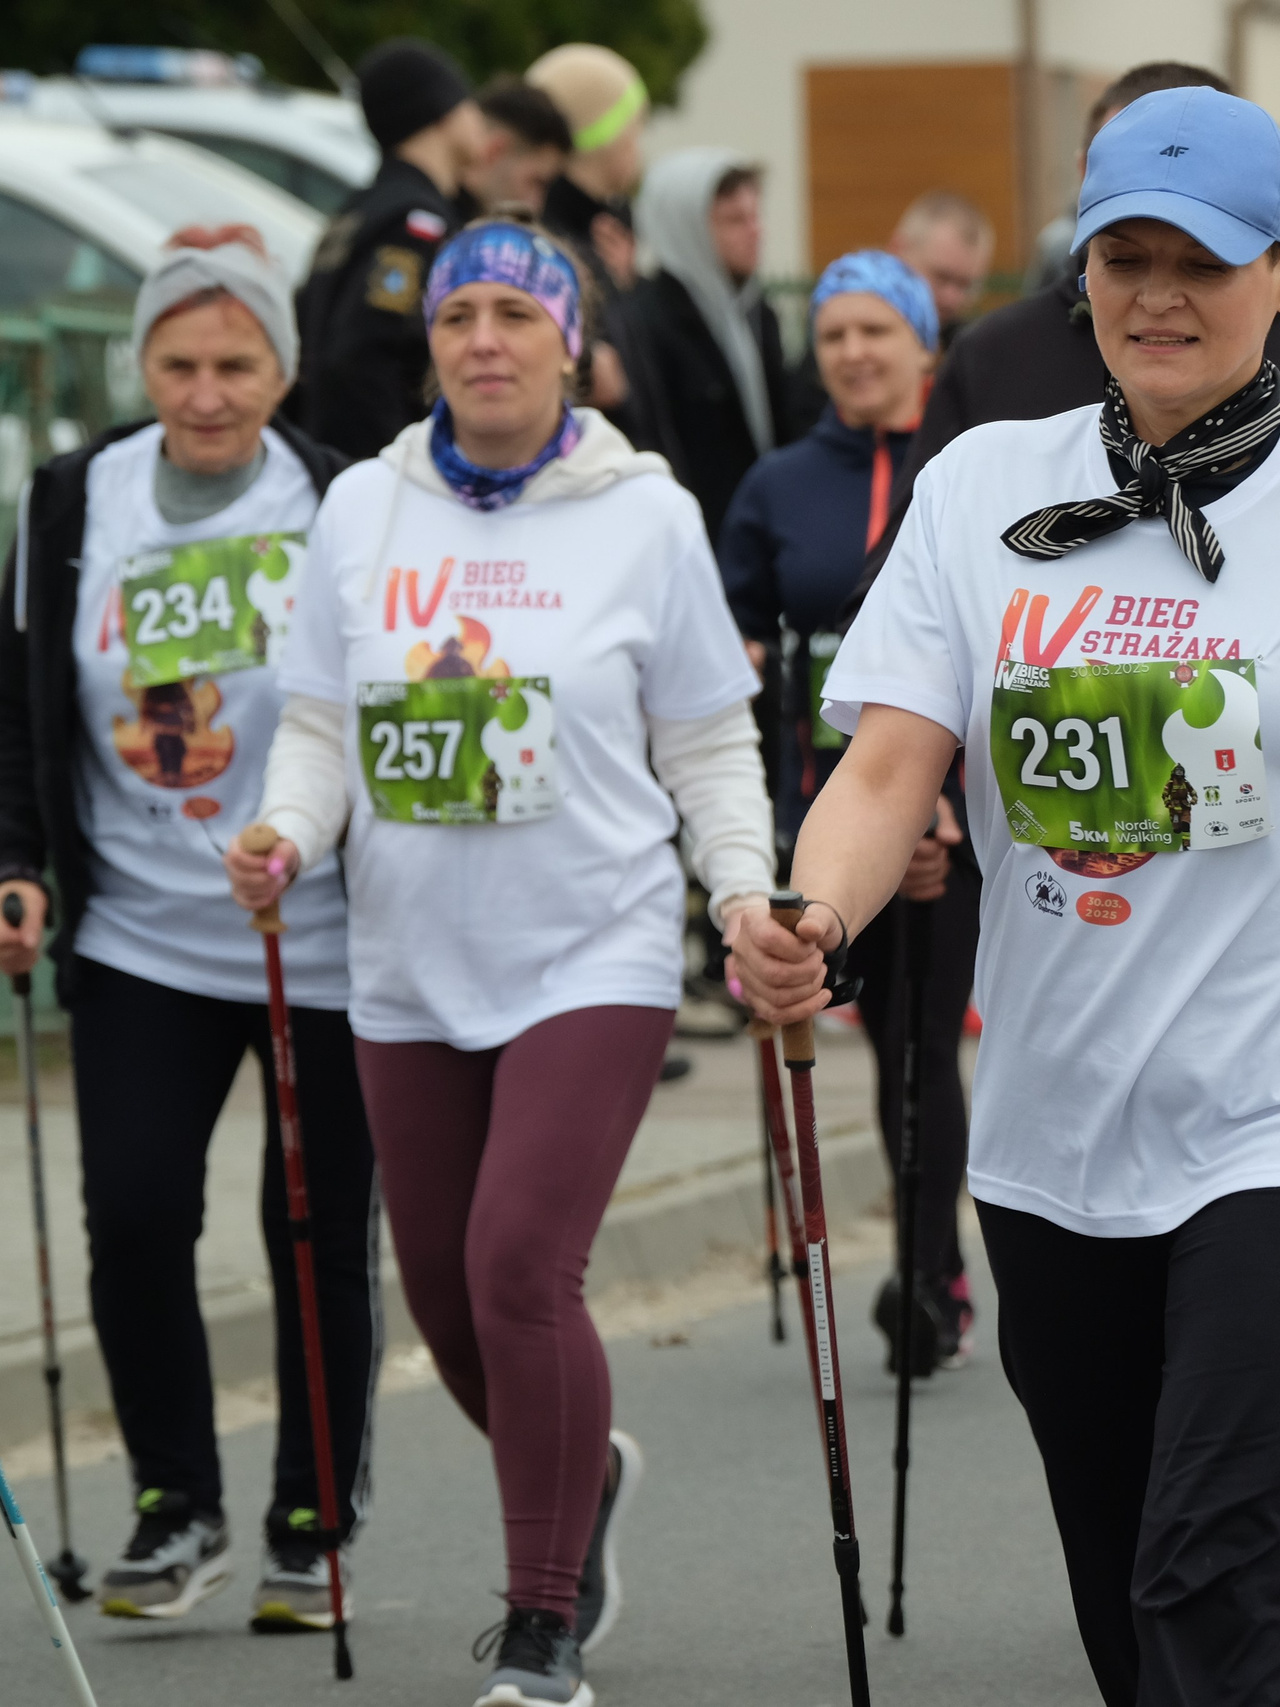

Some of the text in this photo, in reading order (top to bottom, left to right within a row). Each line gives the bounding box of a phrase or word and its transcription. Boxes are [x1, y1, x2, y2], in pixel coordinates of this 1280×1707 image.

[1159, 145, 1189, 158] 4F
[462, 561, 526, 586] BIEG
[384, 556, 455, 632] IV
[449, 588, 563, 610] STRAŻAKA
[131, 575, 234, 646] 234
[1105, 595, 1199, 629] BIEG
[995, 585, 1103, 677] IV
[1080, 630, 1241, 661] STRAŻAKA
[995, 660, 1021, 690] IV
[1017, 664, 1050, 680] BIEG
[1070, 663, 1150, 678] 30.03.2025
[370, 720, 463, 780] 257
[1011, 716, 1129, 791] 231
[1069, 820, 1109, 843] 5KM
[1115, 818, 1160, 831] Nordic
[1115, 829, 1172, 844] Walking
[1085, 908, 1117, 920] 2025
[1087, 897, 1122, 908] 30.03.
